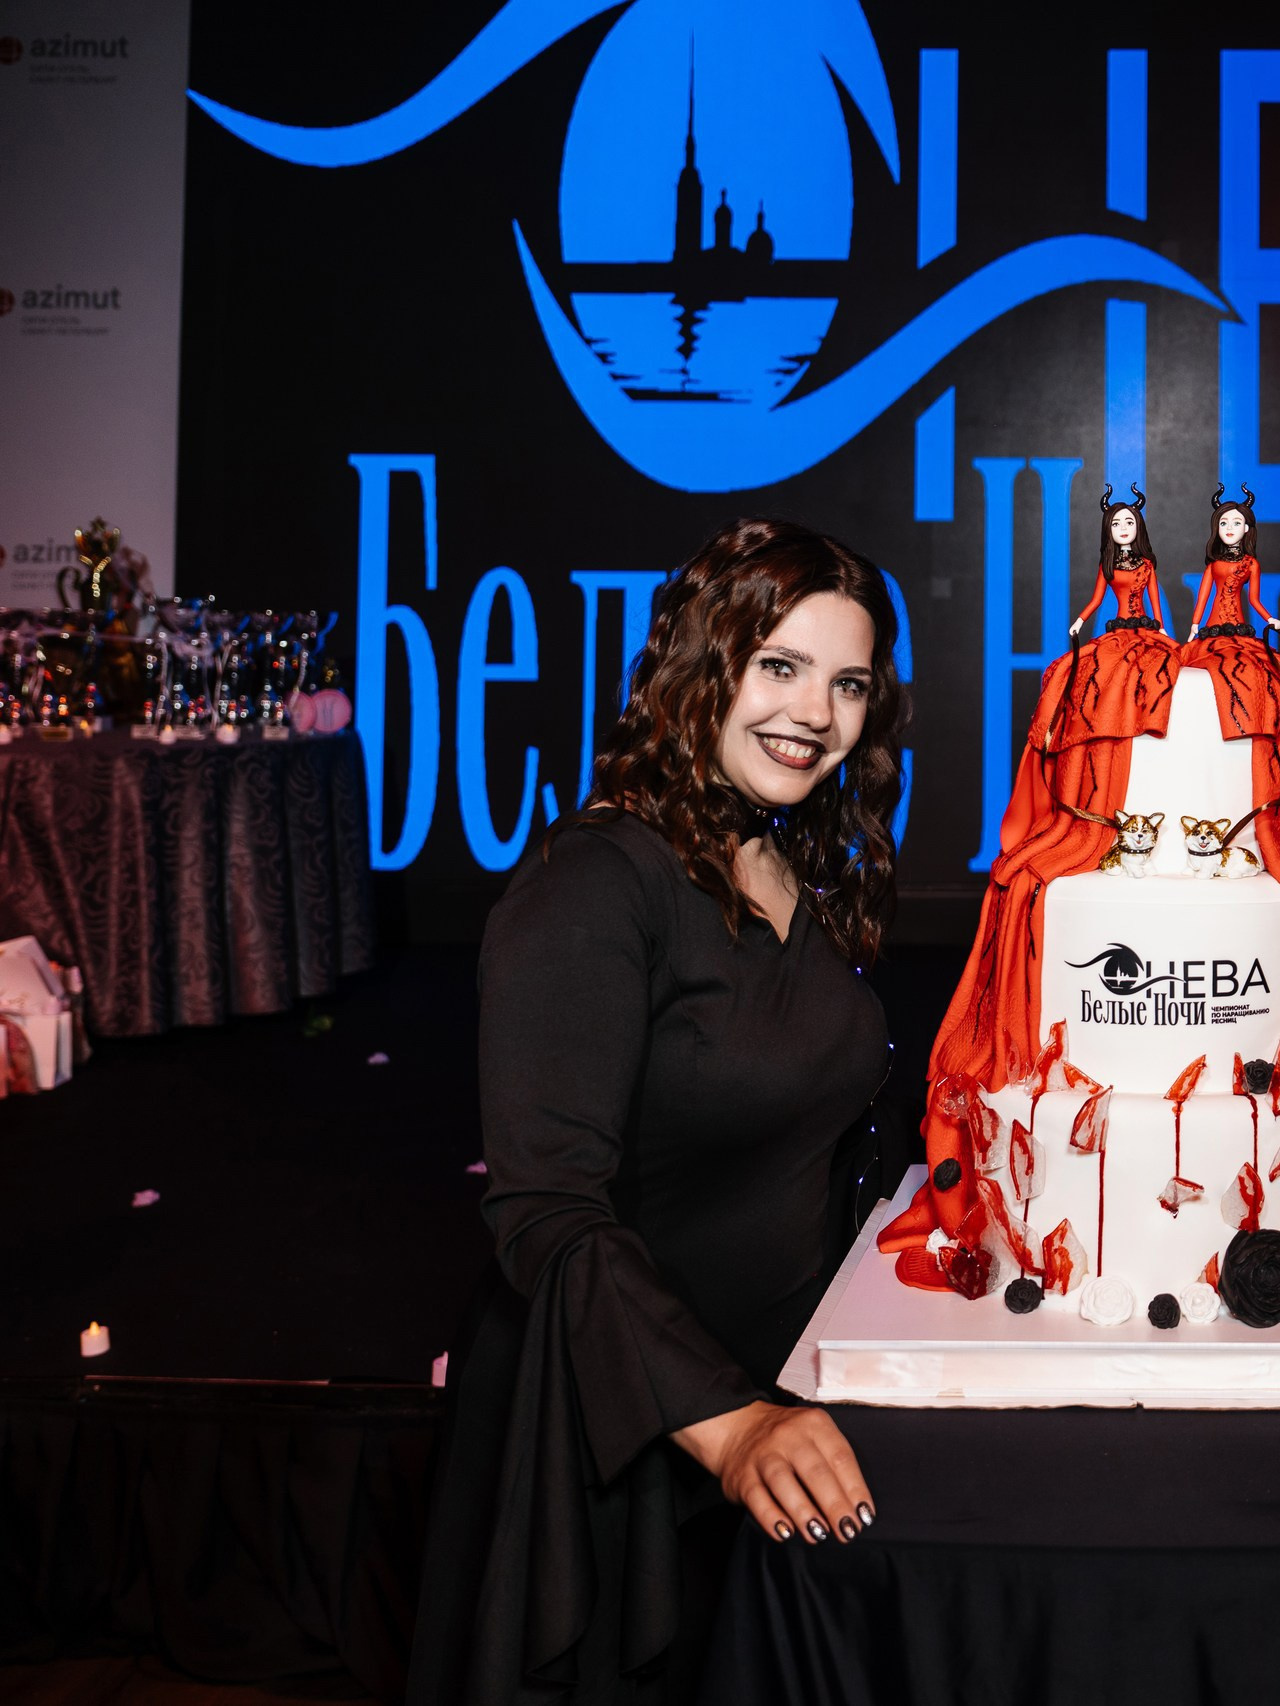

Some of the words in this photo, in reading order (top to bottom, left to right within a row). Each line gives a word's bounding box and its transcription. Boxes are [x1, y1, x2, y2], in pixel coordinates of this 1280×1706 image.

[30, 32, 129, 58] azimut
[22, 283, 121, 309] azimut
[13, 538, 77, 563] azim
[1146, 958, 1270, 998] НЕВА
[1081, 990, 1147, 1025] Белые
[1153, 993, 1206, 1026] Ночи
[1211, 1004, 1250, 1012] ЧЕМПИОНАТ
[1222, 1008, 1270, 1018] НАРАЩИВАНИЮ
